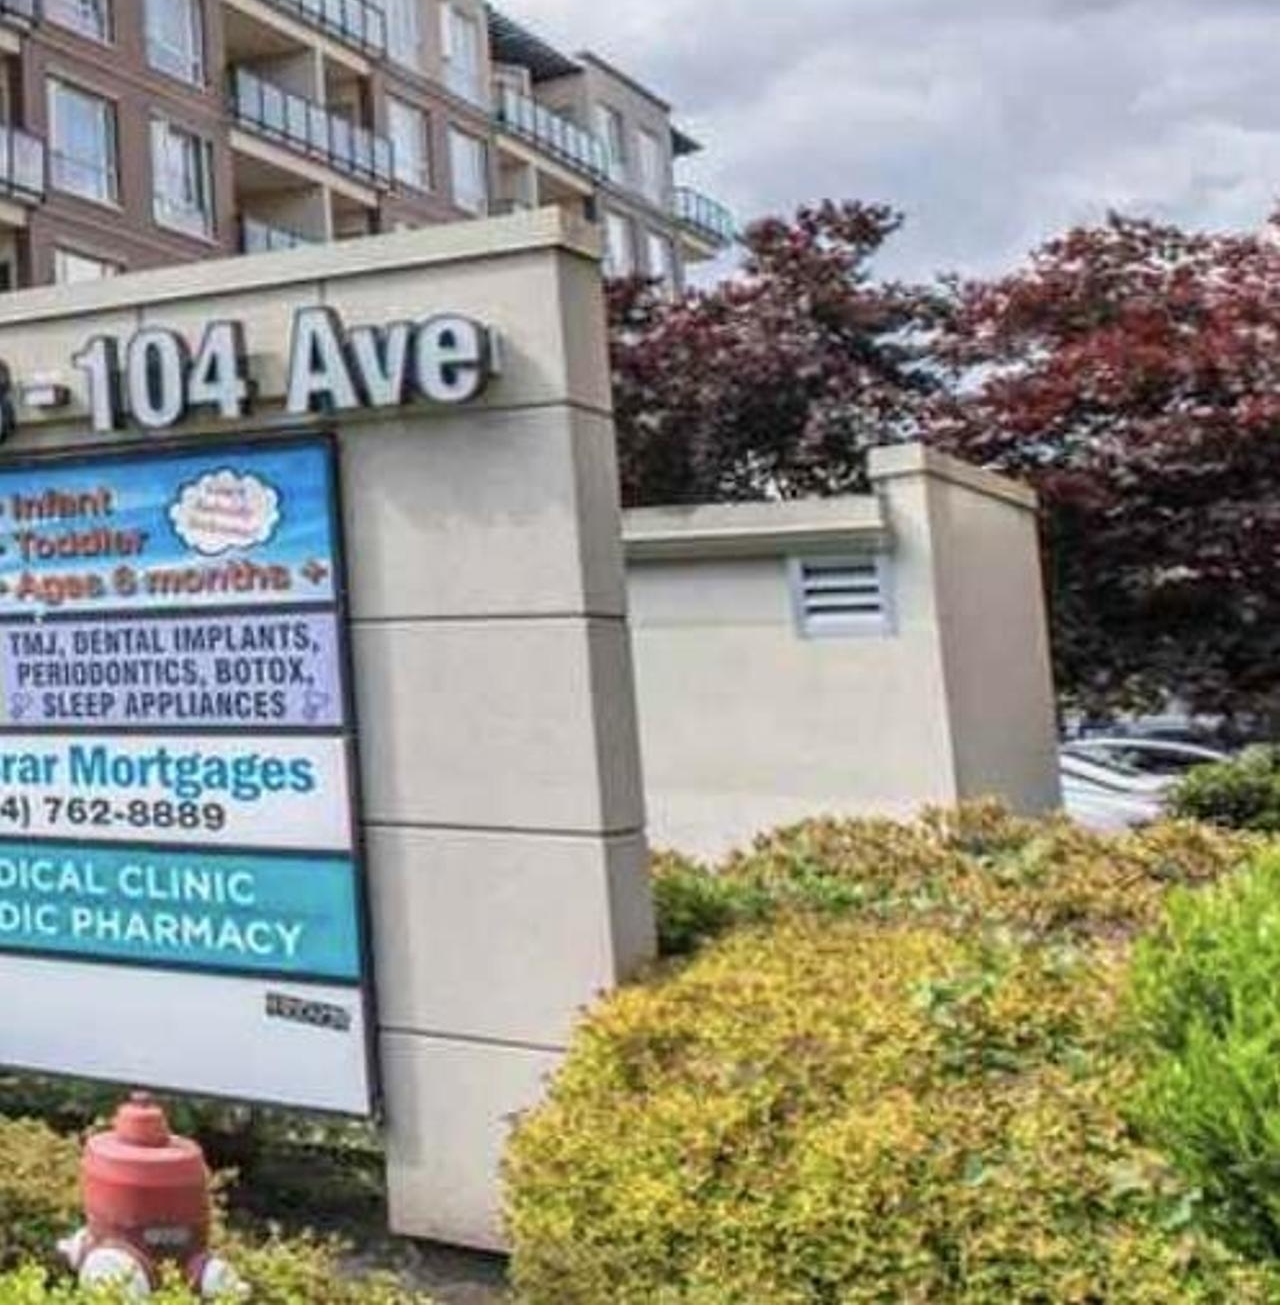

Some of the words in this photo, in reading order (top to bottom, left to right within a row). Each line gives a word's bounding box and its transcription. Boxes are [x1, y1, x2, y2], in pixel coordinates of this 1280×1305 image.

[72, 320, 250, 432] 104
[284, 303, 495, 415] Ave
[12, 485, 114, 521] Infant
[16, 527, 148, 559] Toddler
[14, 573, 100, 603] Ages
[148, 560, 292, 594] months
[10, 632, 65, 658] TMJ,
[74, 627, 165, 655] DENTAL
[174, 621, 320, 652] IMPLANTS,
[17, 659, 208, 688] PERIODONTICS,
[216, 654, 316, 684] BOTOX,
[43, 691, 116, 718] SLEEP
[124, 689, 287, 718] APPLIANCES
[68, 745, 316, 801] Mortgages
[44, 796, 227, 830] 762-8889
[116, 865, 258, 905] CLINIC
[70, 908, 306, 957] PHARMACY
